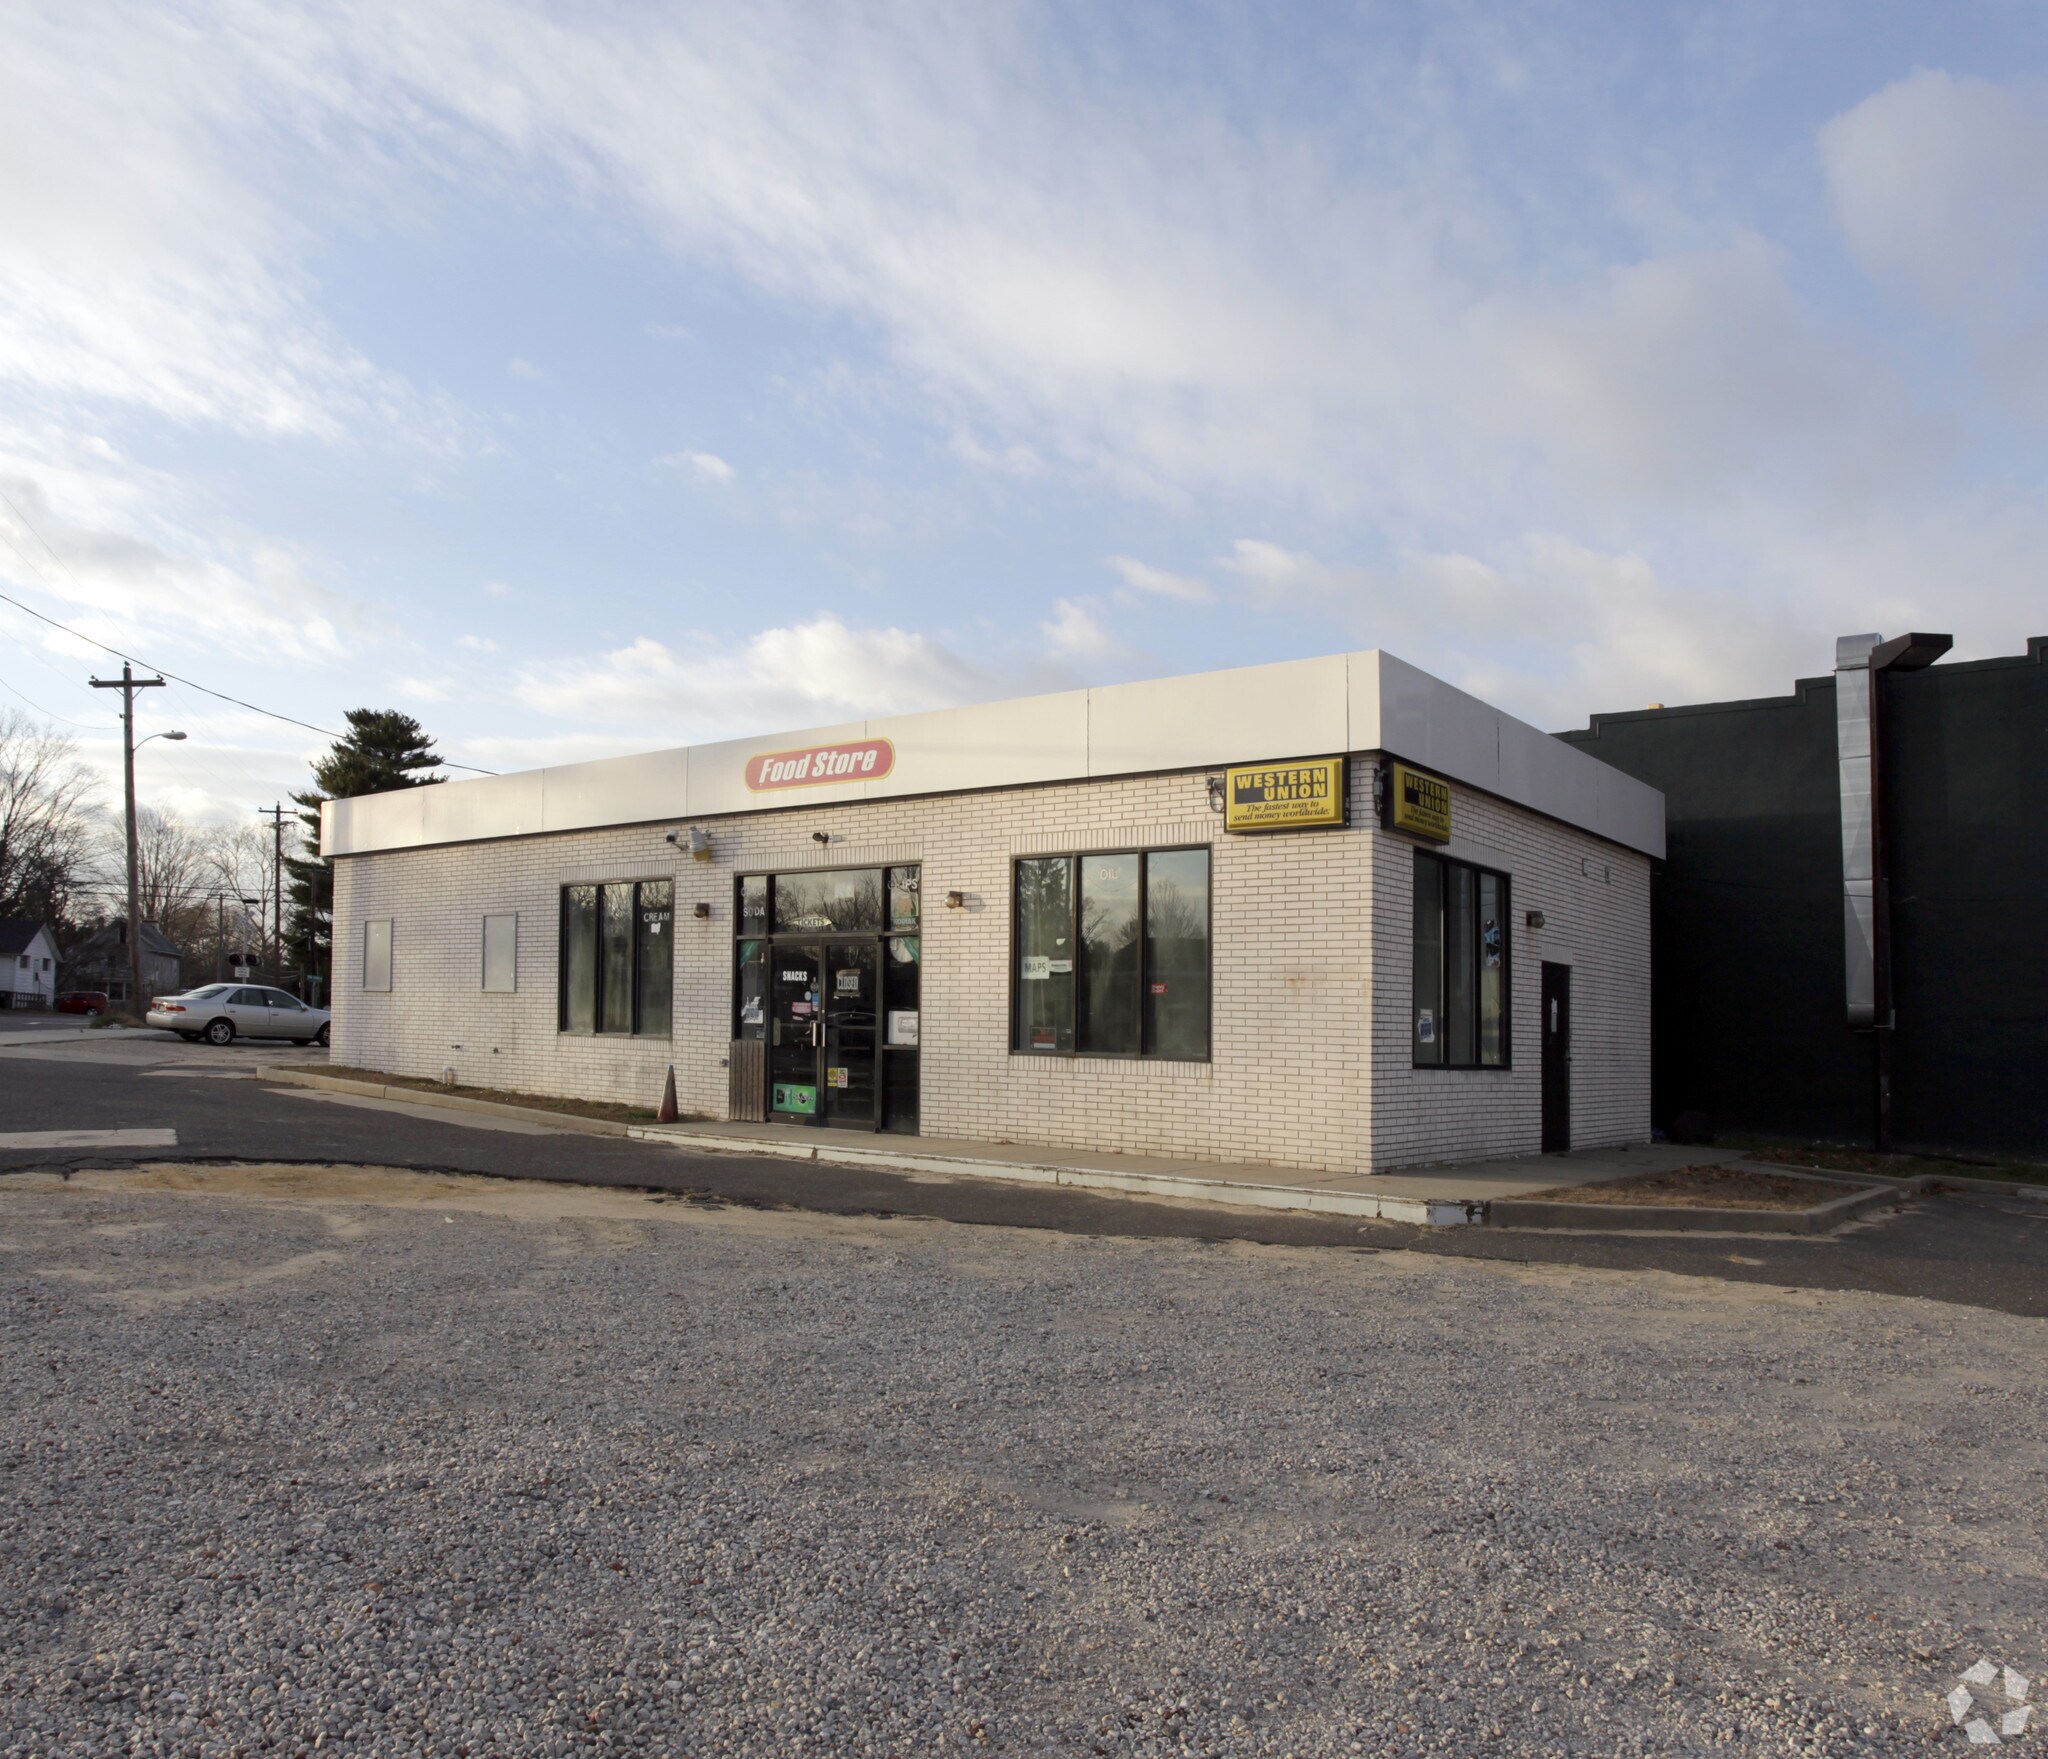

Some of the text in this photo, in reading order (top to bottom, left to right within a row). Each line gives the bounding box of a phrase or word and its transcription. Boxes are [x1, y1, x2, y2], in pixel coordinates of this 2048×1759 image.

[758, 749, 878, 784] Food Store
[1236, 767, 1326, 790] WESTERN
[1263, 782, 1326, 801] UNION
[1405, 773, 1448, 801] WESTERN
[1247, 799, 1319, 812] The fastest way to
[1418, 792, 1448, 814] UNION
[1233, 812, 1253, 821] send
[1254, 811, 1282, 820] money
[1100, 868, 1119, 881] OIL
[643, 911, 670, 922] CREAM
[743, 906, 765, 917] SODA
[1024, 962, 1047, 973] MAPS
[782, 970, 808, 982] SNACKS
[836, 975, 859, 990] CLOSED
